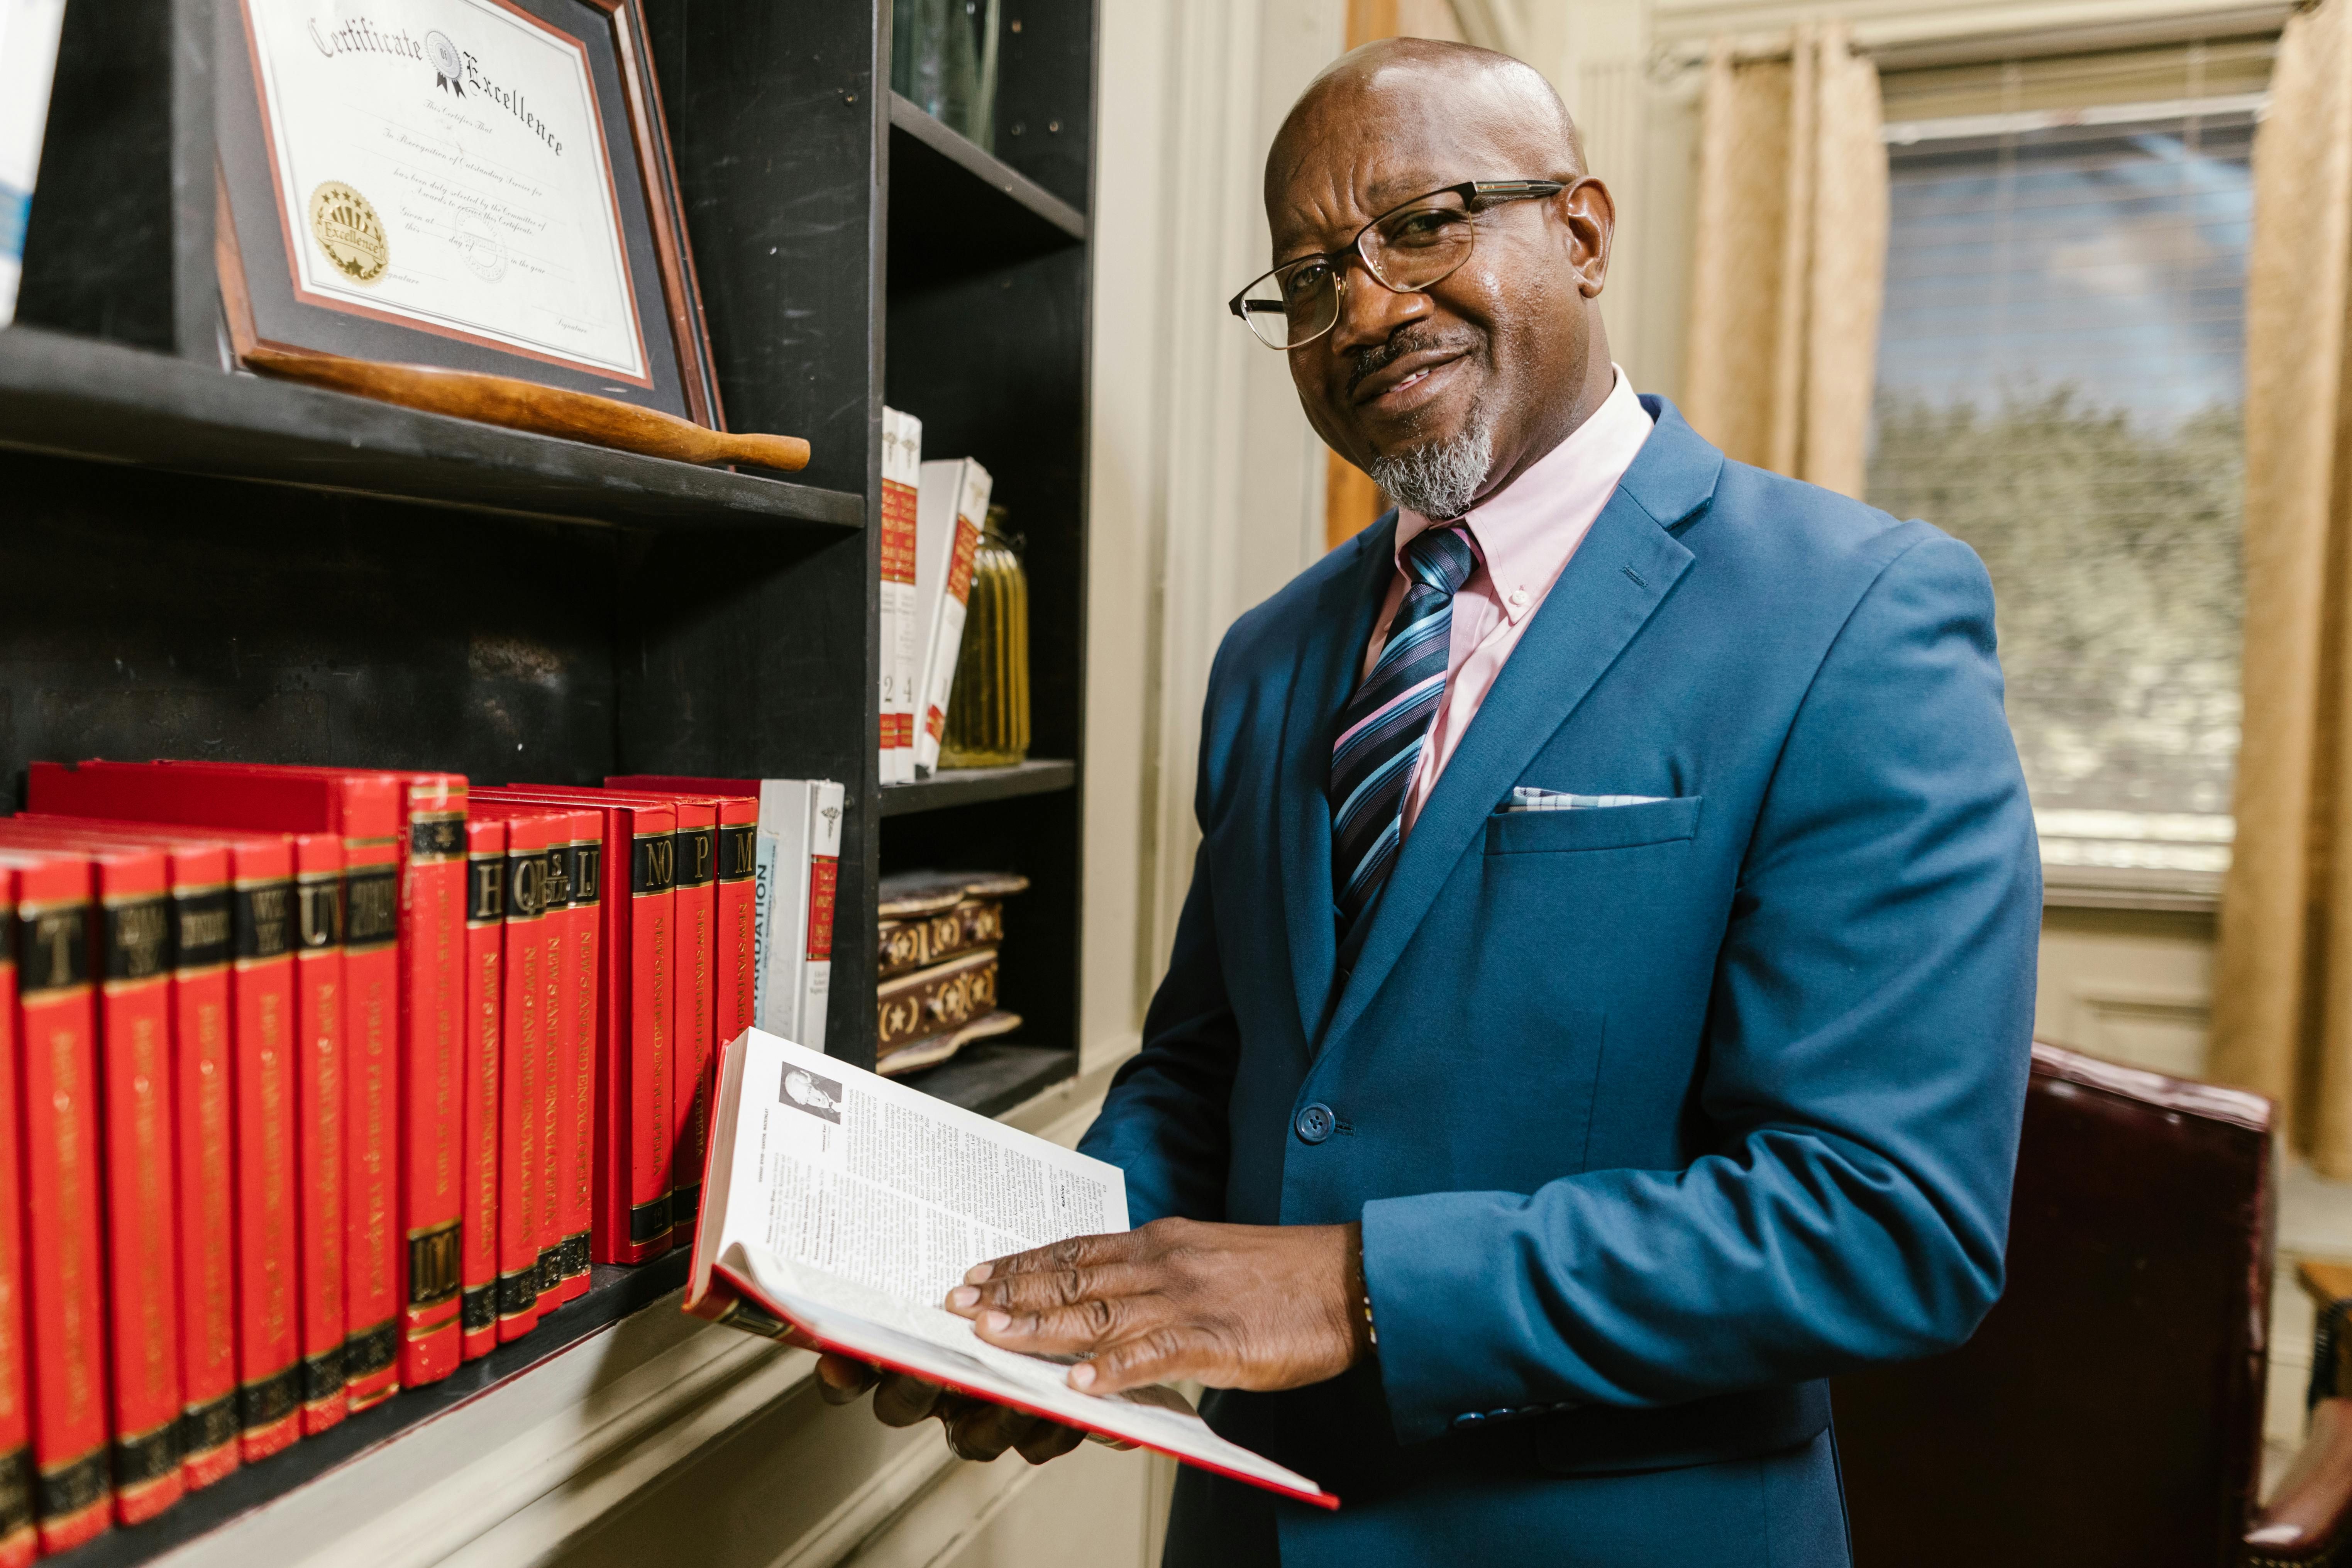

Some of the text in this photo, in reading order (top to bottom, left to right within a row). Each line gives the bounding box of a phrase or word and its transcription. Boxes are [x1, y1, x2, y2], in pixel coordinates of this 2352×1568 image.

[308, 17, 423, 61] Certificate
[463, 51, 562, 156] Excellence
[423, 99, 492, 133] This Certifies That
[383, 128, 542, 196] In Recognition of Outstanding Service for
[393, 168, 546, 231] has been duly selected by the Committee of
[400, 205, 422, 221] Given
[411, 187, 446, 204] Awards
[457, 205, 482, 217] receive
[483, 212, 497, 224] this
[498, 215, 533, 235] Certificate.
[324, 222, 378, 254] Excellence
[405, 222, 419, 233] this
[449, 236, 462, 249] day
[465, 239, 475, 252] of
[388, 274, 419, 284] gnature
[555, 318, 587, 333] Signature
[884, 676, 893, 703] 2
[903, 676, 913, 703] 4
[645, 840, 673, 886] NO
[695, 836, 708, 878] P
[735, 832, 753, 873] M
[476, 864, 503, 917] H
[738, 902, 747, 939] NEW
[483, 952, 498, 999] NEW
[737, 942, 747, 1024] STANDARD
[482, 1002, 496, 1107] STANDARD
[654, 917, 664, 1176] NEW STANDARD ENCYCLOPEDIA
[695, 909, 705, 1157] NEW STANDARD ENCYCLOPEDIA
[545, 937, 560, 1225] NEW STANDARD ENCYCLOPEDIA
[577, 931, 591, 1210] NEW STANDARD ENCYCLOPEDIA
[521, 947, 537, 1244] NEW STANDARD ENCYCLOPEDIA
[654, 1207, 663, 1229] 12
